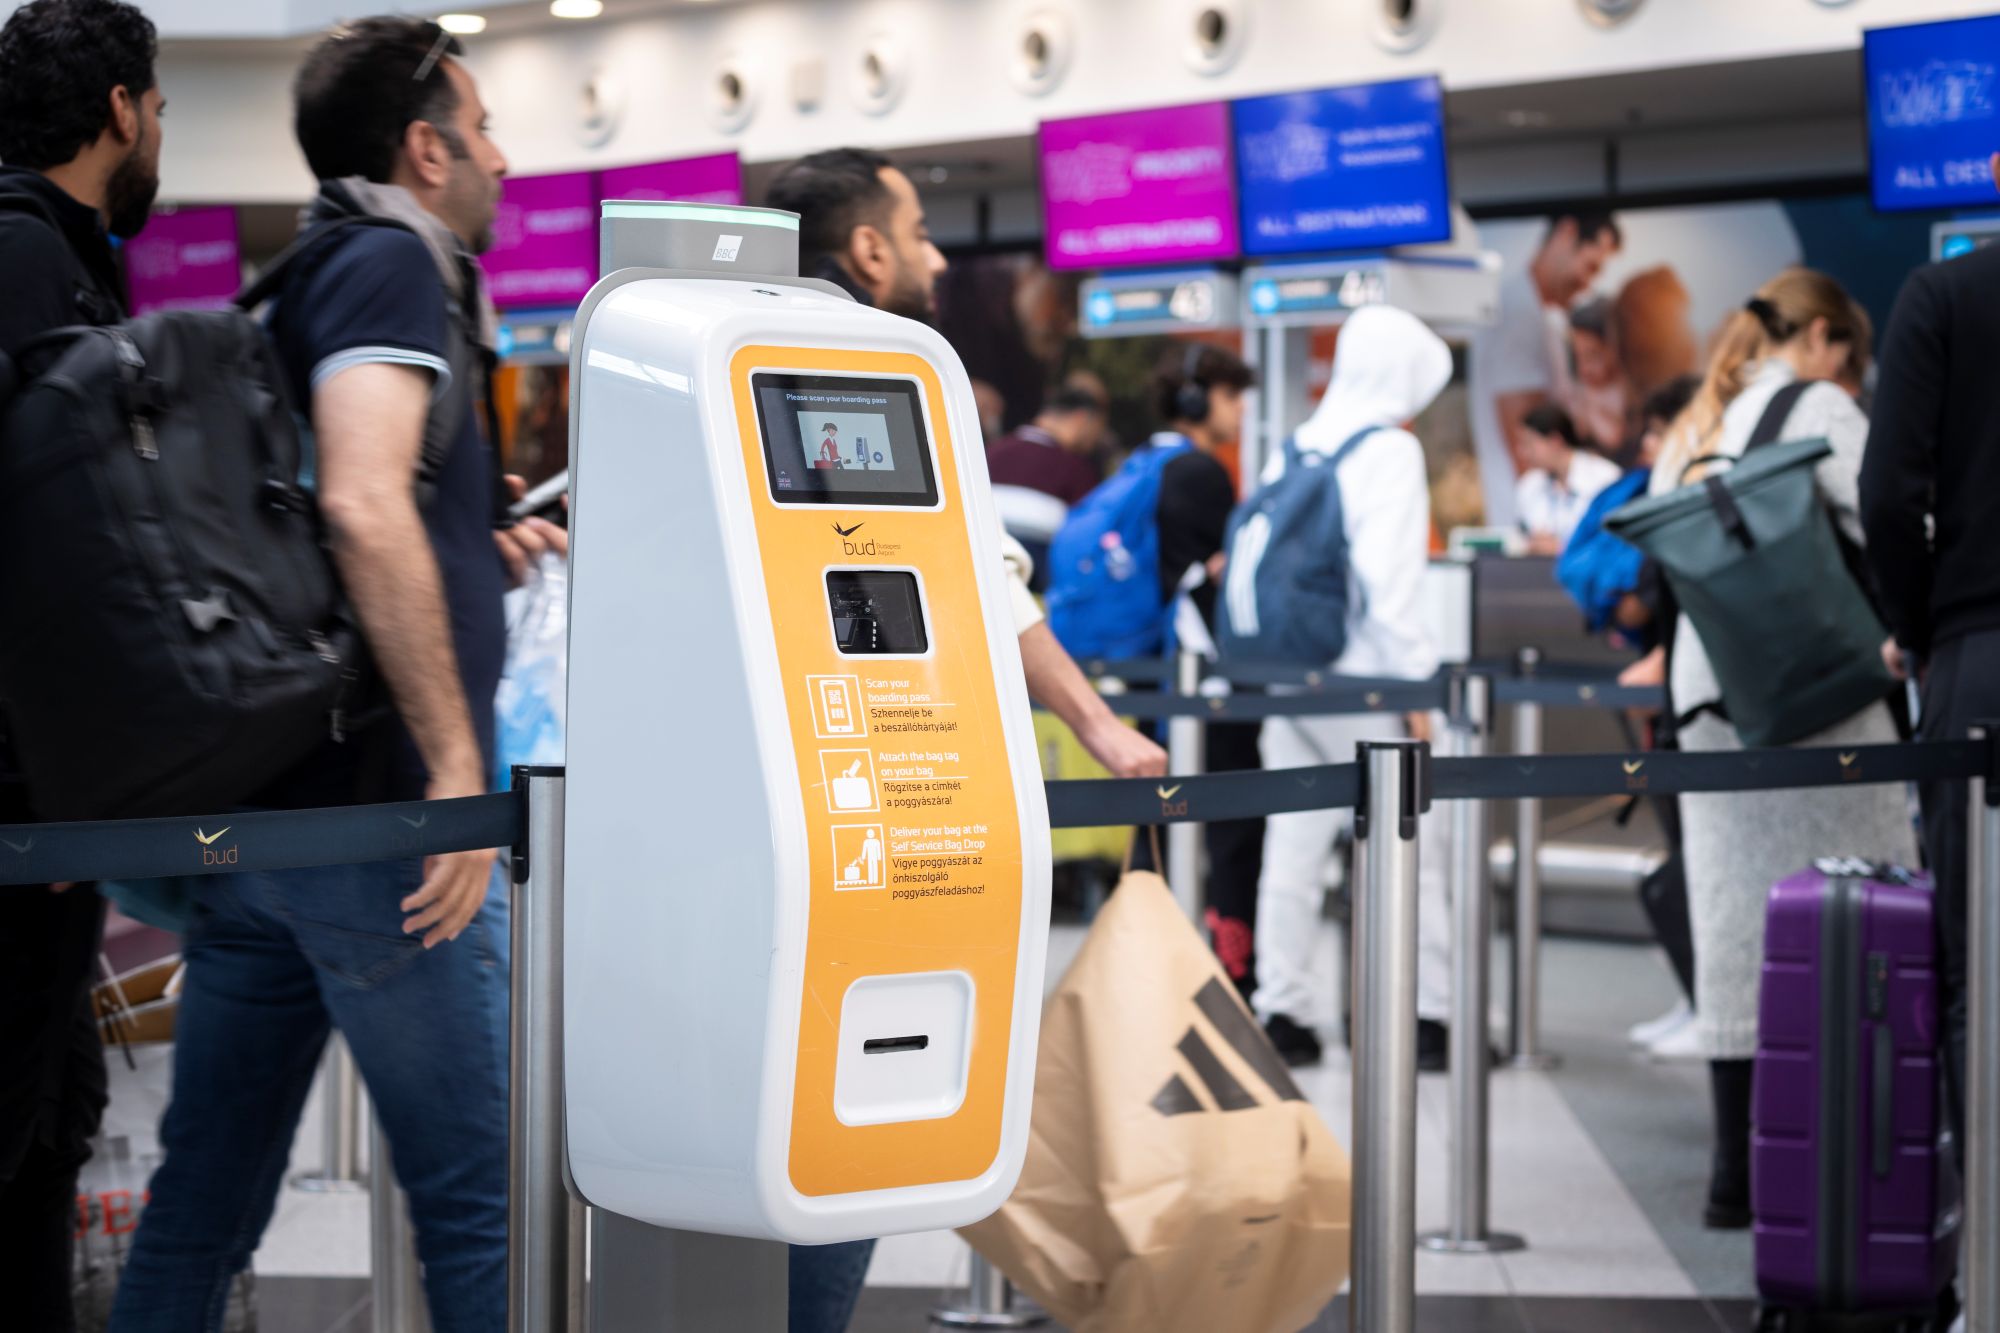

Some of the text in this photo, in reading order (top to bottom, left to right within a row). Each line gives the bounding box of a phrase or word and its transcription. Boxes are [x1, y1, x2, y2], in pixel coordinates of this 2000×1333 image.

[715, 248, 737, 259] BBC
[786, 393, 808, 402] Please
[825, 396, 841, 404] your
[842, 396, 871, 405] boarding
[842, 538, 876, 556] bud
[866, 678, 910, 690] Scan your
[868, 692, 930, 704] boarding pass
[871, 708, 933, 719] Szkennelje be
[879, 751, 960, 763] Attach the bag tag
[895, 767, 915, 778] your
[916, 766, 934, 778] bag
[886, 796, 953, 808] a poggyászára!
[890, 824, 988, 837] Deliver your bag at the
[891, 839, 985, 852] Self Service Bag Drop
[203, 844, 238, 866] bud
[893, 856, 983, 870] Vigye poggyászát az
[893, 872, 949, 884] önkiszolgáló
[892, 885, 985, 900] poggyászfeladáshoz!
